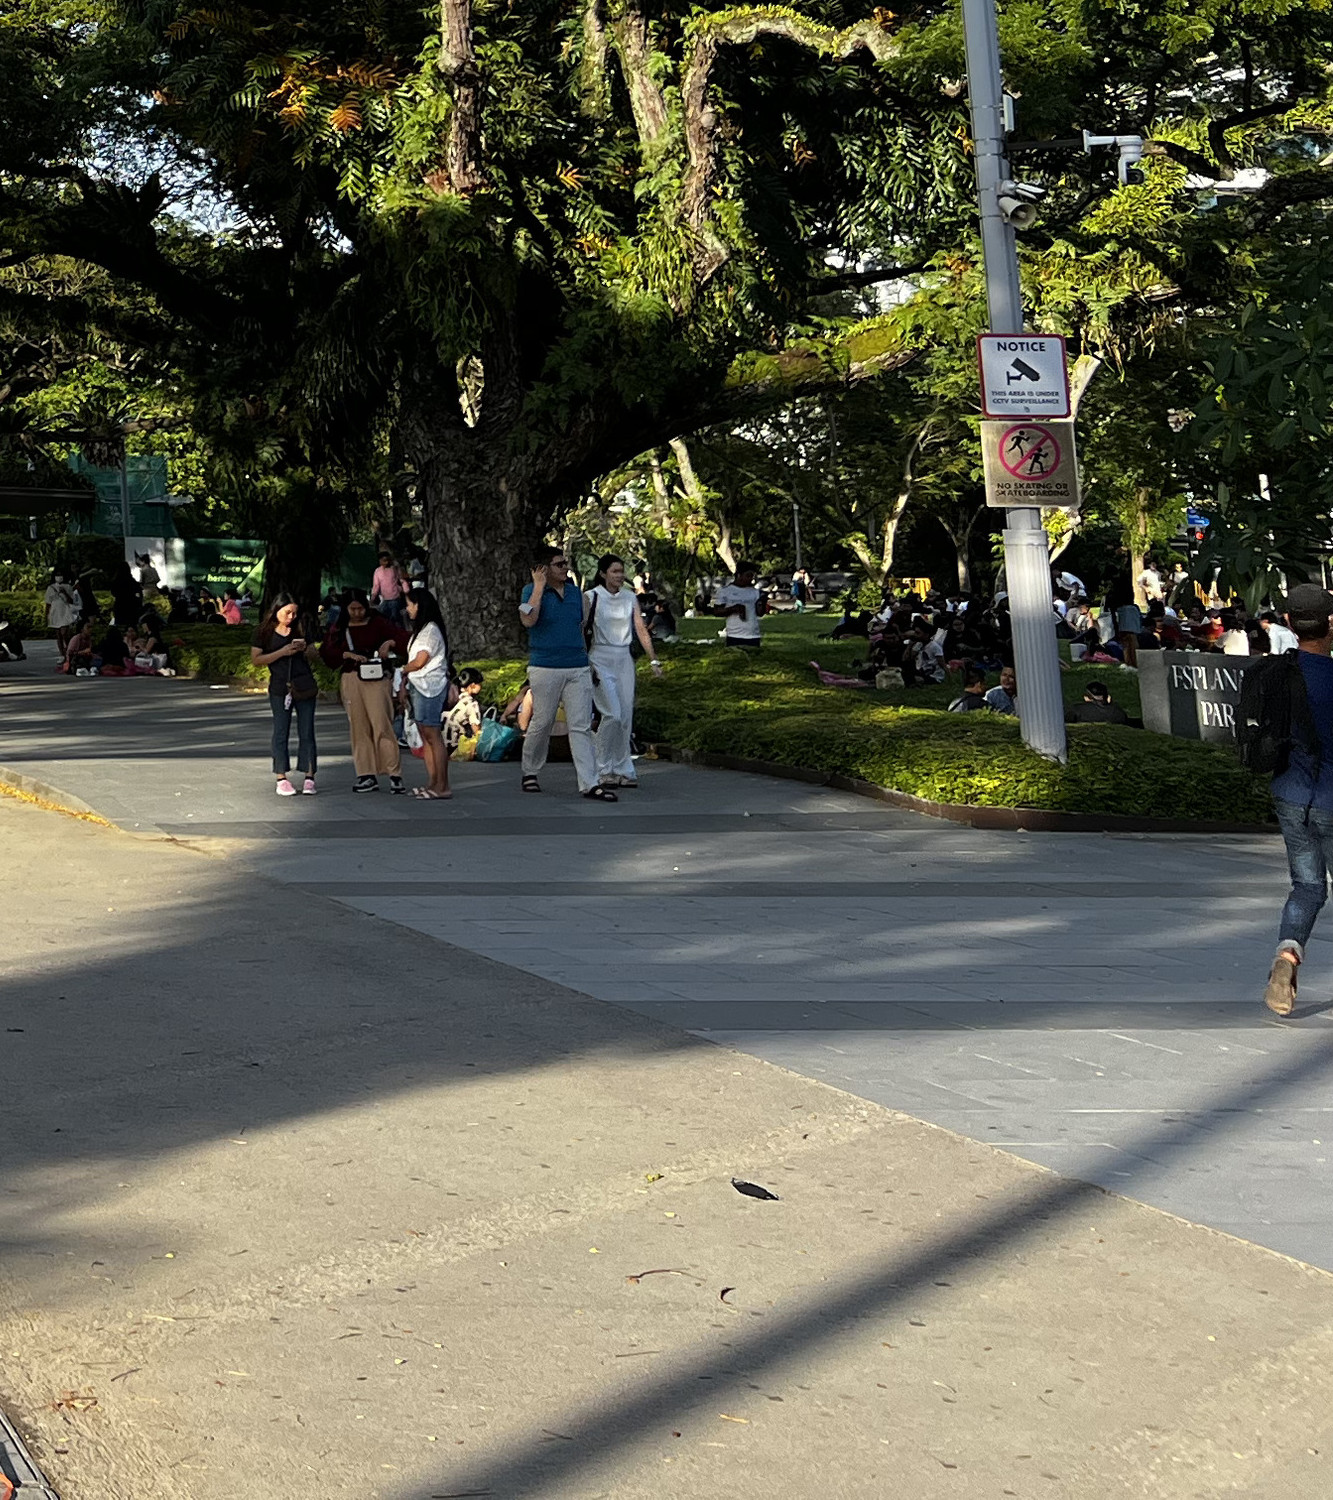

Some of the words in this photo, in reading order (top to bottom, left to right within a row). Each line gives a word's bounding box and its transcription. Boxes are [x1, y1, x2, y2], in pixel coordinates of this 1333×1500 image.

[997, 341, 1046, 352] NOTICE
[1036, 390, 1060, 398] UNDER
[996, 482, 1011, 490] NO
[995, 489, 1071, 497] SKATEBOARDING
[1200, 700, 1236, 728] PAR
